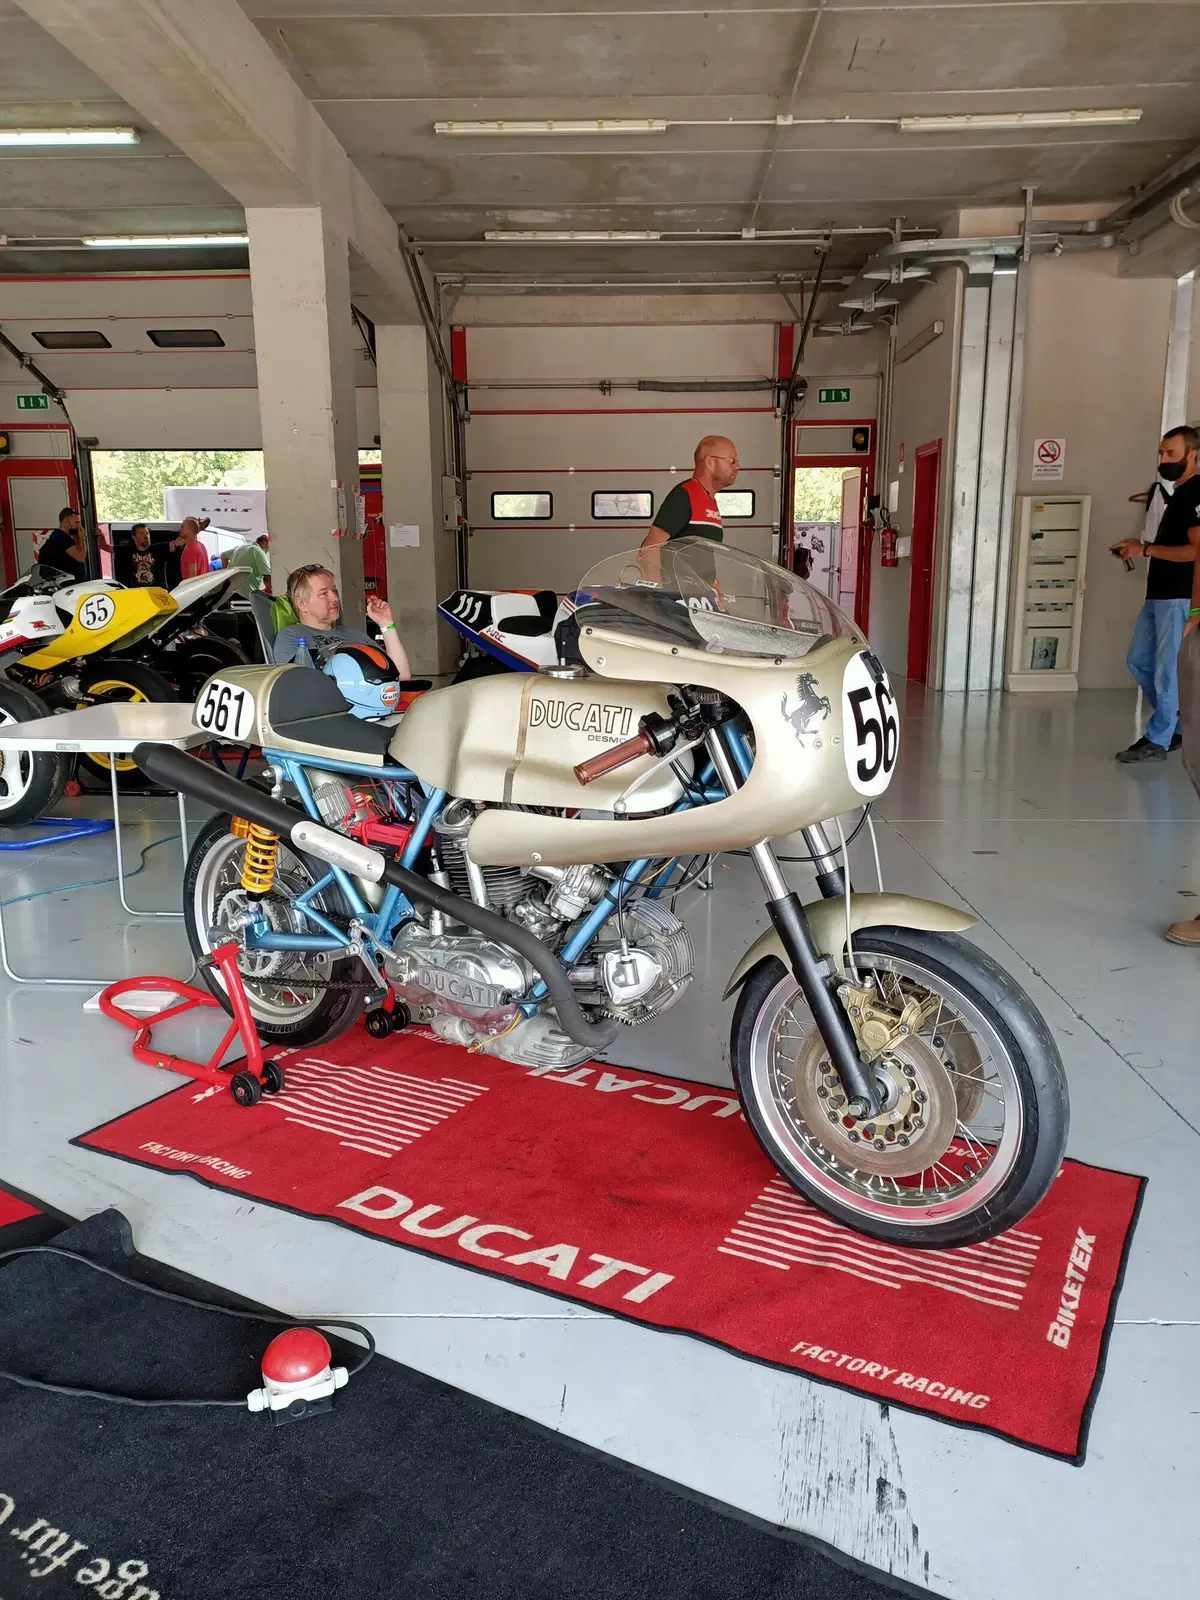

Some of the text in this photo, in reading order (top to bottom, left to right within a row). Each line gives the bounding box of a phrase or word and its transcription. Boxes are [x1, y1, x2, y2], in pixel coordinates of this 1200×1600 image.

[85, 597, 108, 626] 55
[452, 593, 482, 624] 111
[201, 683, 245, 737] 561
[530, 699, 633, 735] DUCATI
[421, 970, 493, 1006] DUCATI
[525, 1065, 748, 1122] UCATI
[138, 1141, 252, 1179] FACTORY RACING
[335, 1185, 676, 1304] DUCATI
[1046, 1226, 1096, 1349] BIKETEK
[790, 1341, 991, 1409] FACTORY RACING
[10, 1518, 88, 1577] für
